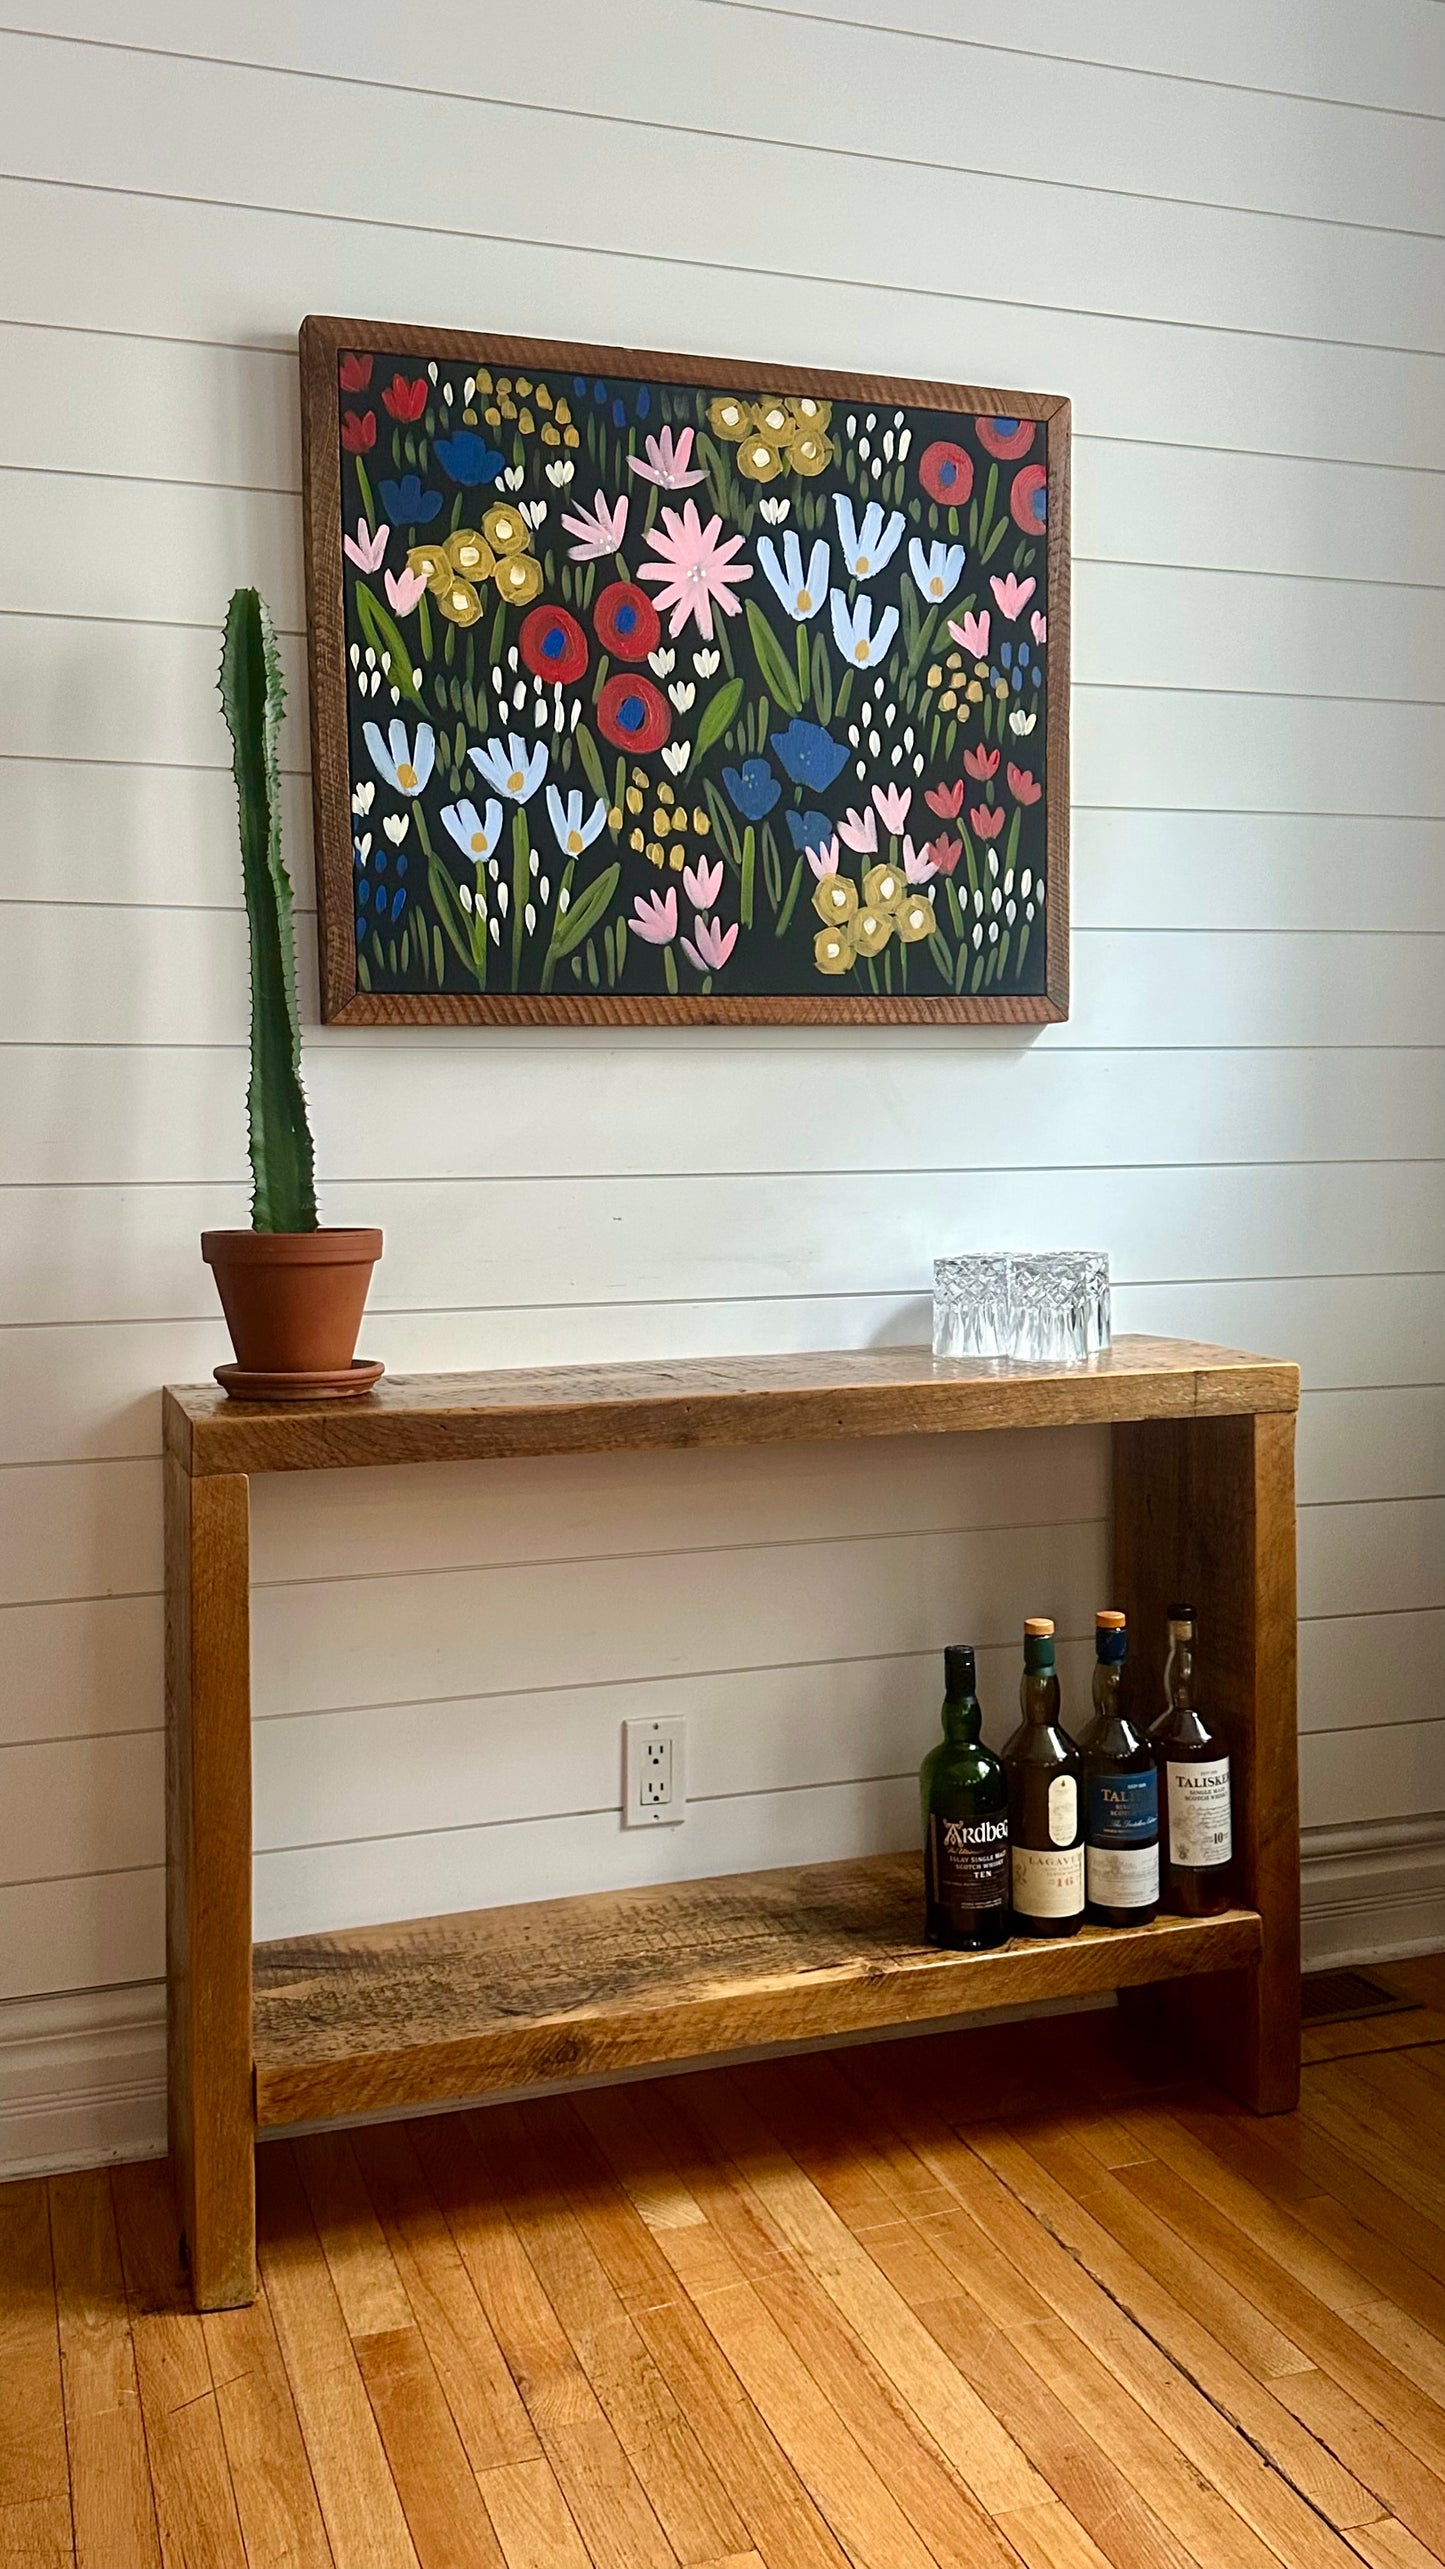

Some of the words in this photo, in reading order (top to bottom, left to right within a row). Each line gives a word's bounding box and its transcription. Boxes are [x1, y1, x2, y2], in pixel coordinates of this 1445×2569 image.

[1213, 1831, 1224, 1845] 10
[973, 1870, 992, 1879] TEN
[1057, 1876, 1074, 1888] 16
